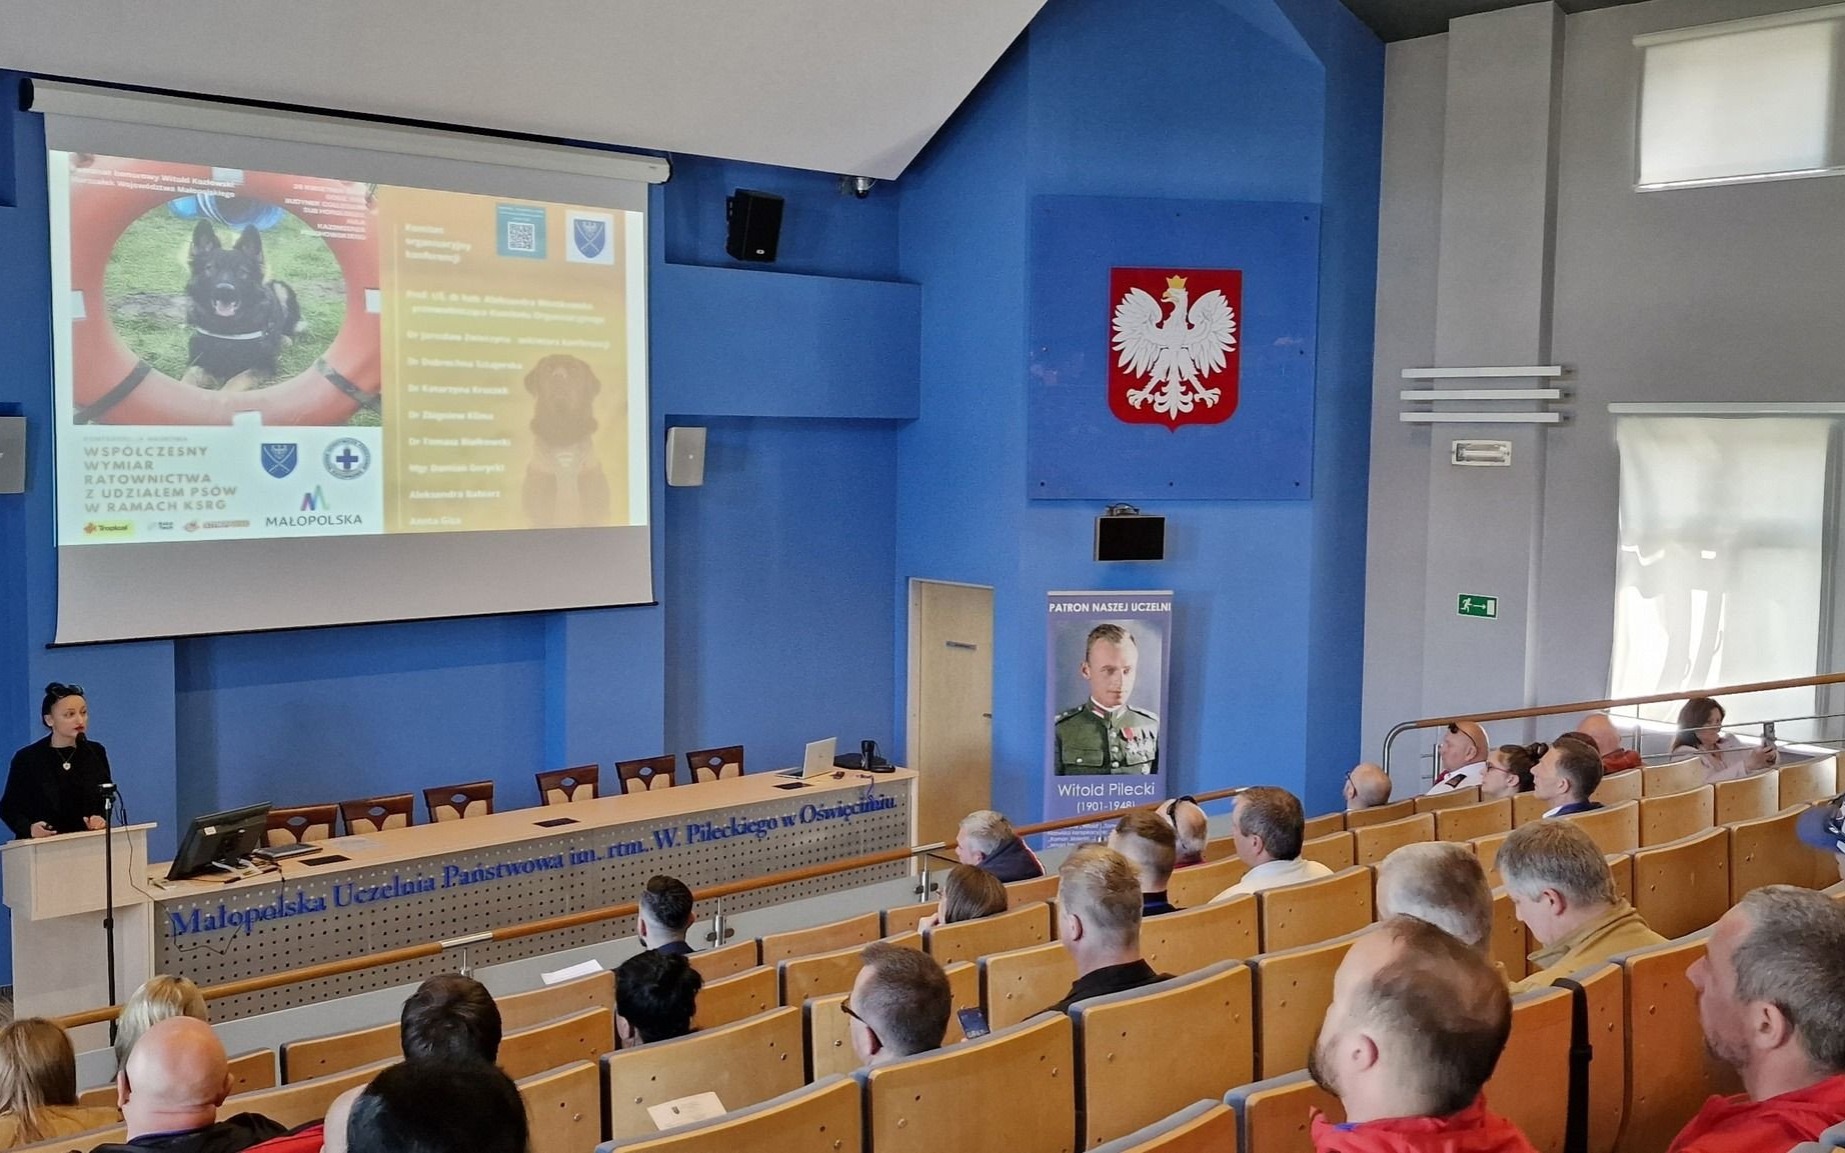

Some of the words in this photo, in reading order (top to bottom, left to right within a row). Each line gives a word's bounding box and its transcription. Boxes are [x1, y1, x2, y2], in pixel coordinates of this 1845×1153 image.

[84, 461, 154, 471] WYMIAR
[84, 473, 212, 485] RATOWNICTWA
[85, 488, 94, 499] Z
[84, 502, 100, 513] W
[107, 500, 178, 512] RAMACH
[184, 499, 226, 511] KSRG
[265, 514, 363, 527] MAŁOPOLSKA
[1049, 603, 1089, 613] PATRON
[1092, 602, 1129, 612] NASZEJ
[1131, 602, 1171, 612] UCZELNI
[1058, 783, 1104, 797] Witold
[1109, 782, 1155, 796] Pilecki
[169, 892, 328, 938] Małopolska
[332, 873, 437, 908] Uczelnia
[442, 854, 564, 889] Państwowa
[570, 847, 601, 865] im.
[653, 828, 680, 851] W.
[685, 816, 778, 845] Pileckiego
[781, 814, 798, 828] w
